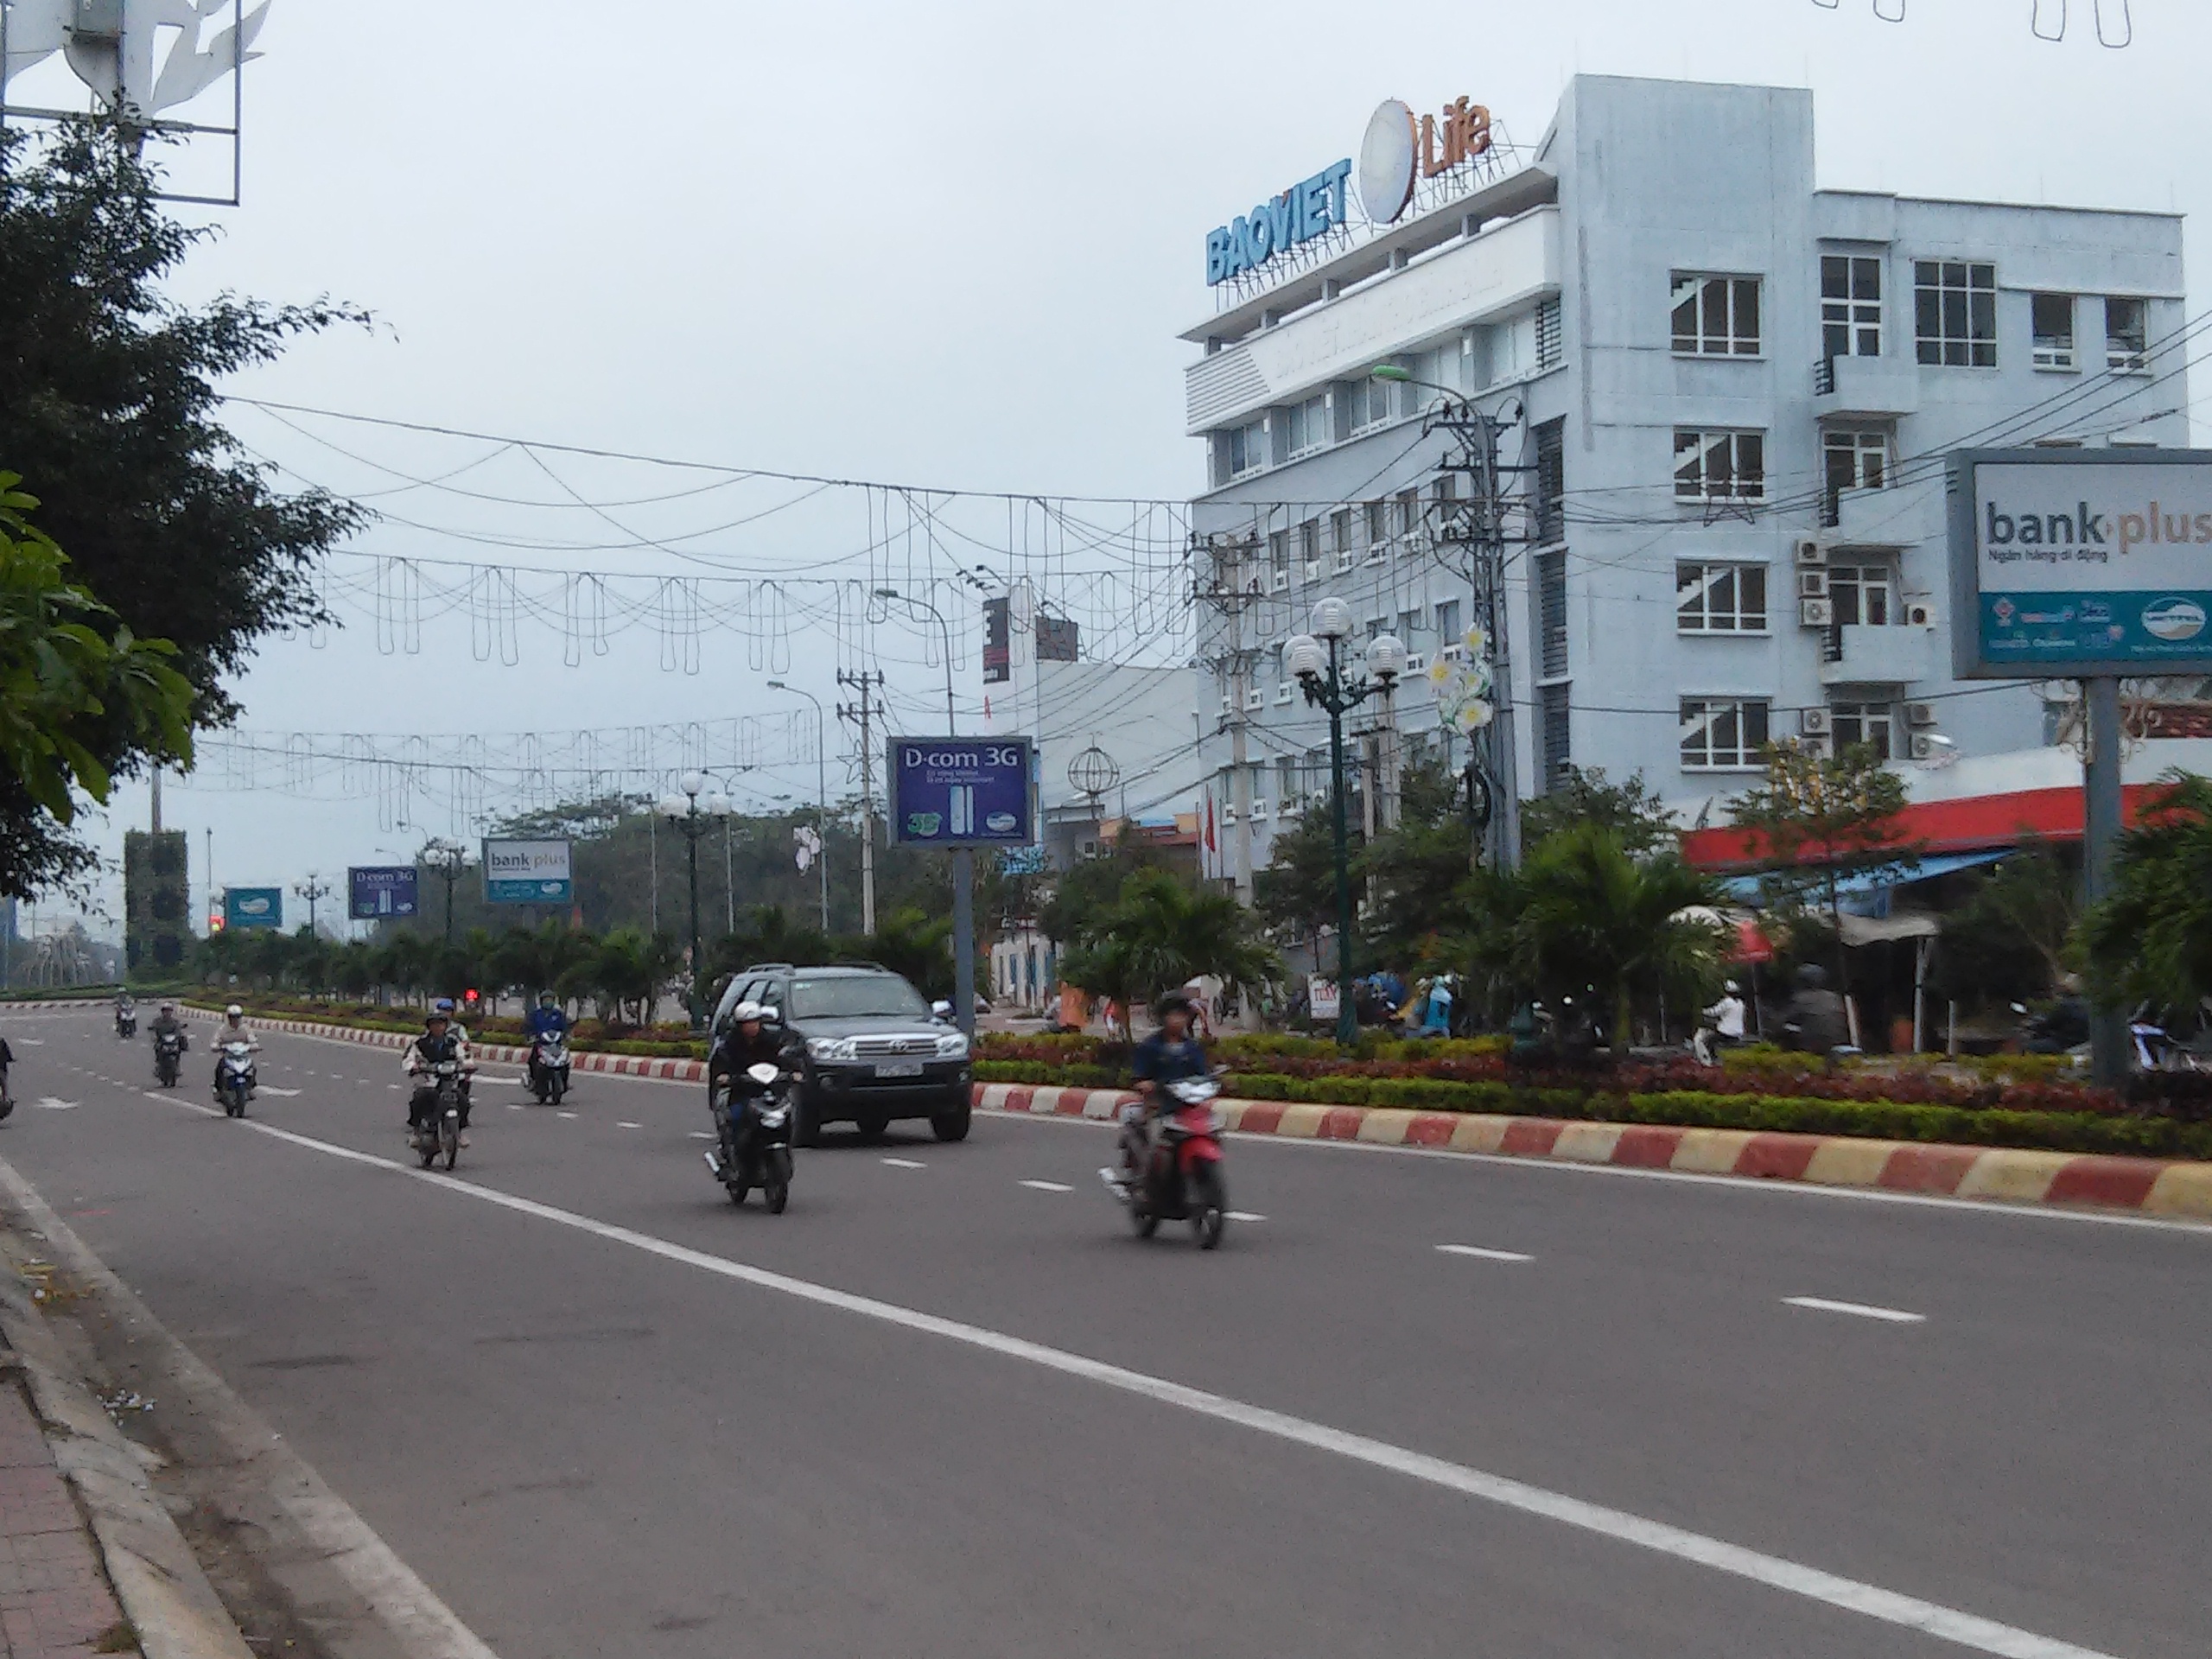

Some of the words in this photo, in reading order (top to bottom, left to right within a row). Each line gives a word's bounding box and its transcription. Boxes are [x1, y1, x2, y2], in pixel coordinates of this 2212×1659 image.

[1422, 95, 1491, 179] Life
[1987, 500, 2106, 544] bank
[2117, 500, 2212, 555] plus
[984, 747, 1018, 767] 3G
[492, 853, 530, 866] bank
